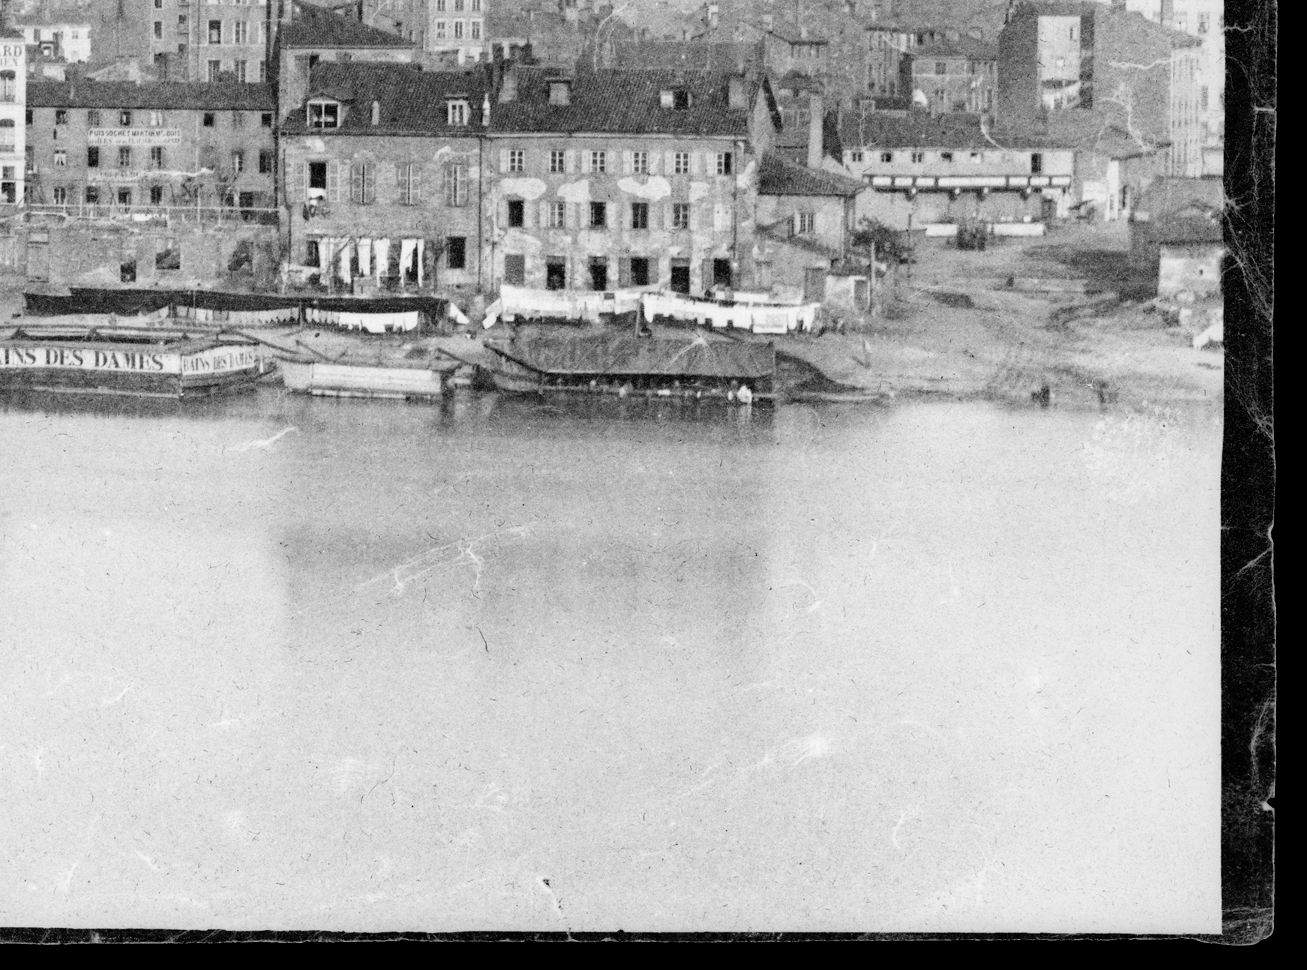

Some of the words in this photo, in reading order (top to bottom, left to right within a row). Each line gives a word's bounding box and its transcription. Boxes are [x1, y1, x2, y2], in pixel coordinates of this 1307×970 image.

[44, 349, 85, 367] DES
[94, 351, 165, 372] DAMES
[182, 356, 211, 372] BAINS
